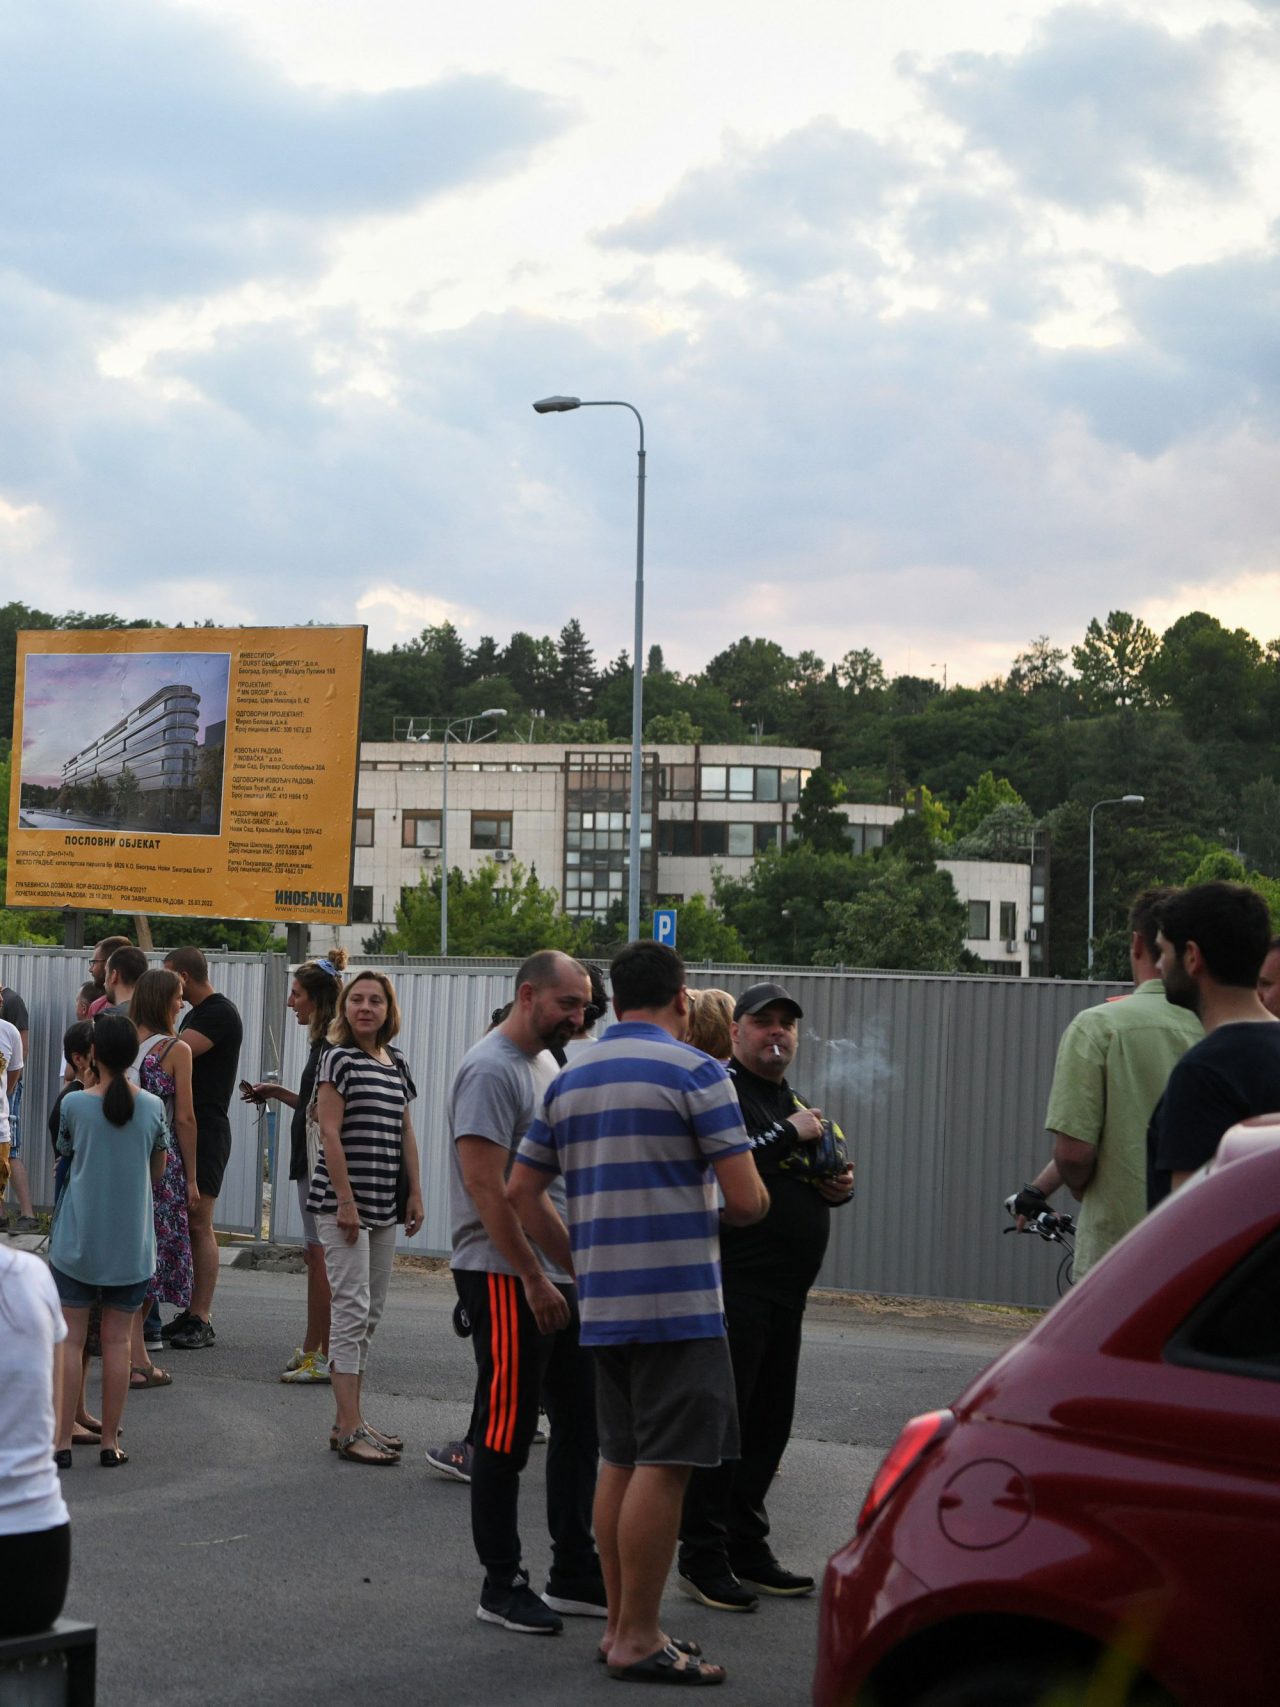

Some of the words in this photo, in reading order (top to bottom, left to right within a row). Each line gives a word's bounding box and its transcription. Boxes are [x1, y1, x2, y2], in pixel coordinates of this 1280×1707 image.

[65, 836, 115, 847] ПОСЛОВНИ
[119, 838, 160, 849] ОБЈЕКАТ
[275, 889, 343, 908] ИНОБАЧКА
[659, 915, 671, 942] P
